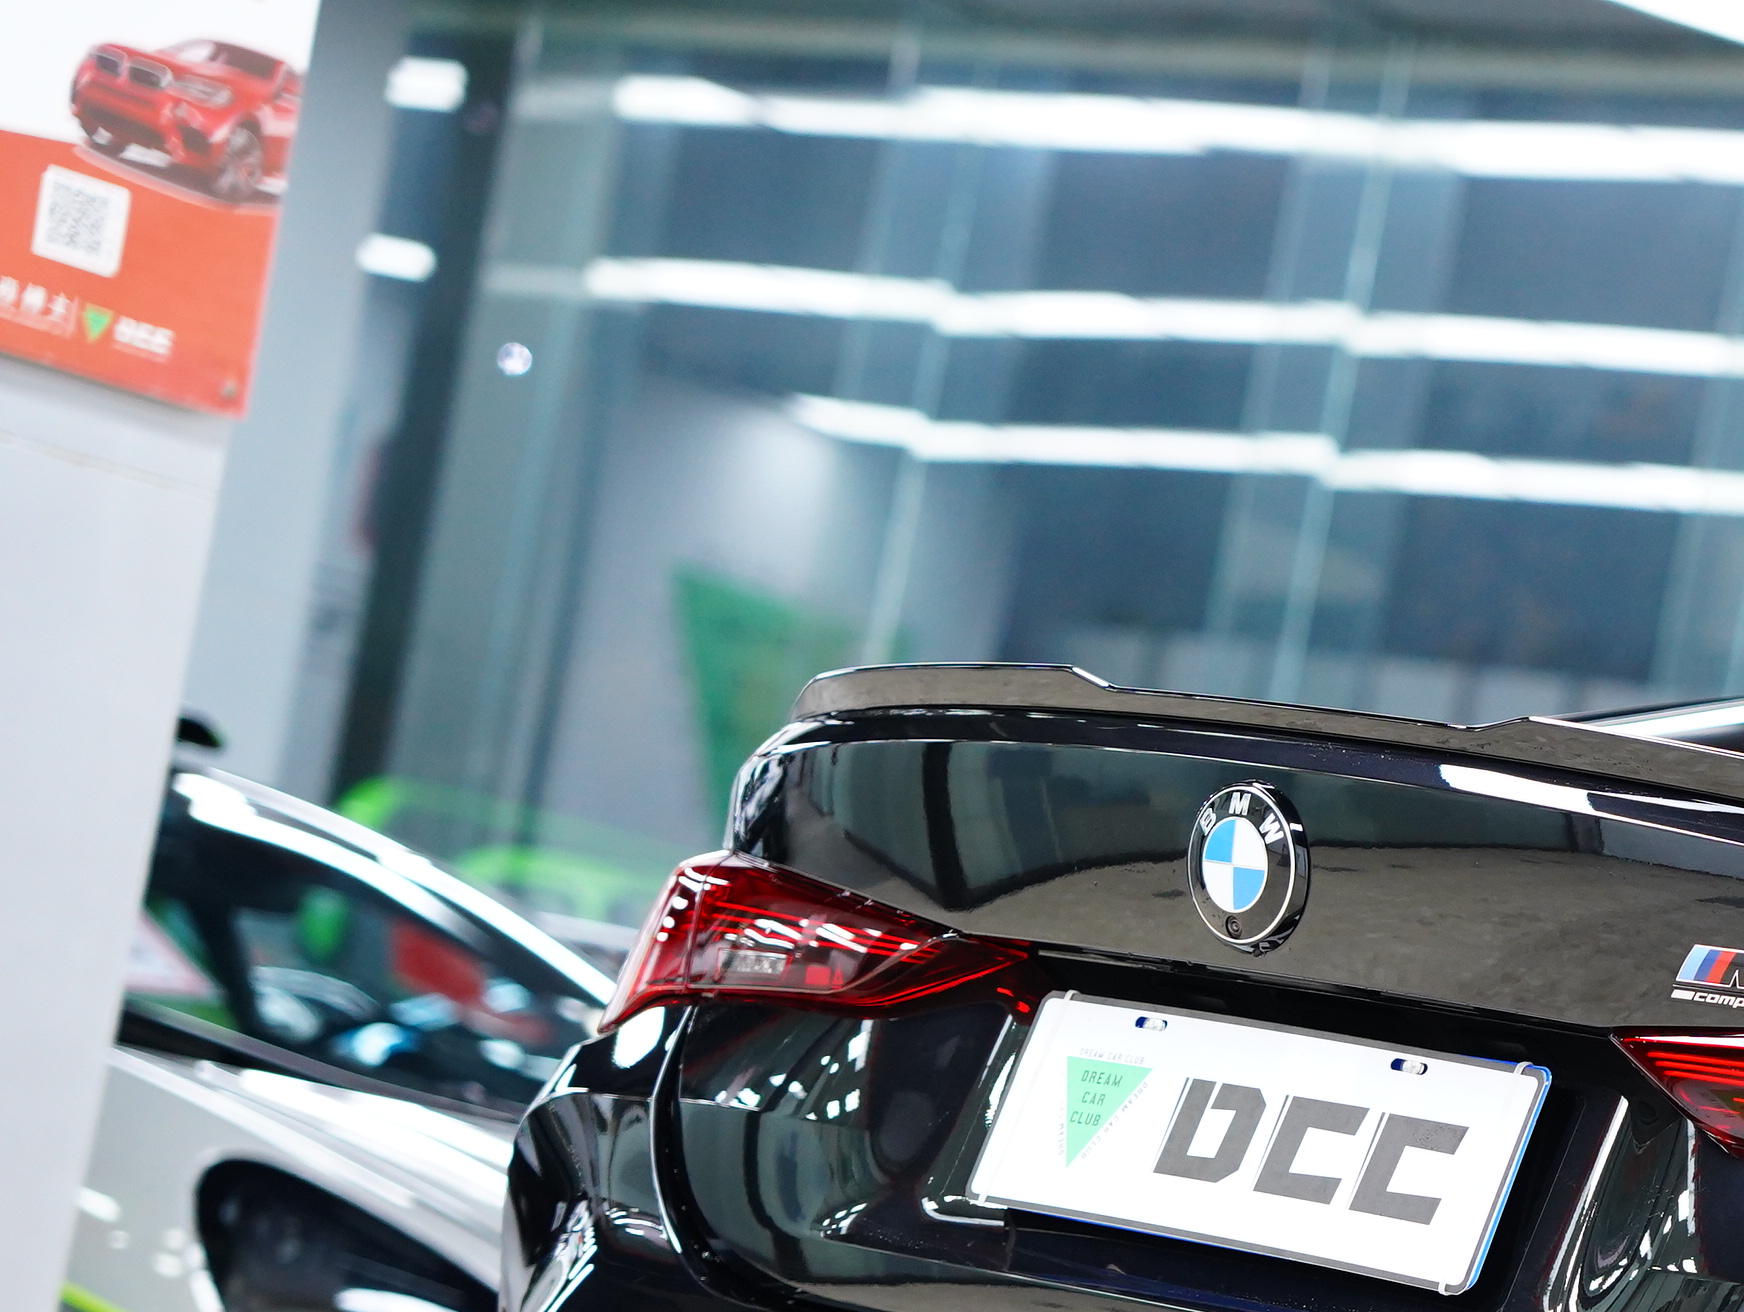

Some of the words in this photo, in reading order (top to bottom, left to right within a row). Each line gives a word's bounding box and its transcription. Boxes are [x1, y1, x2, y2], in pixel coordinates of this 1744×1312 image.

[1200, 791, 1285, 845] BMW
[1080, 1069, 1124, 1088] DREAM
[1081, 1091, 1106, 1107] CAR
[1069, 1110, 1102, 1127] CLUB
[1152, 1077, 1470, 1226] DCC
